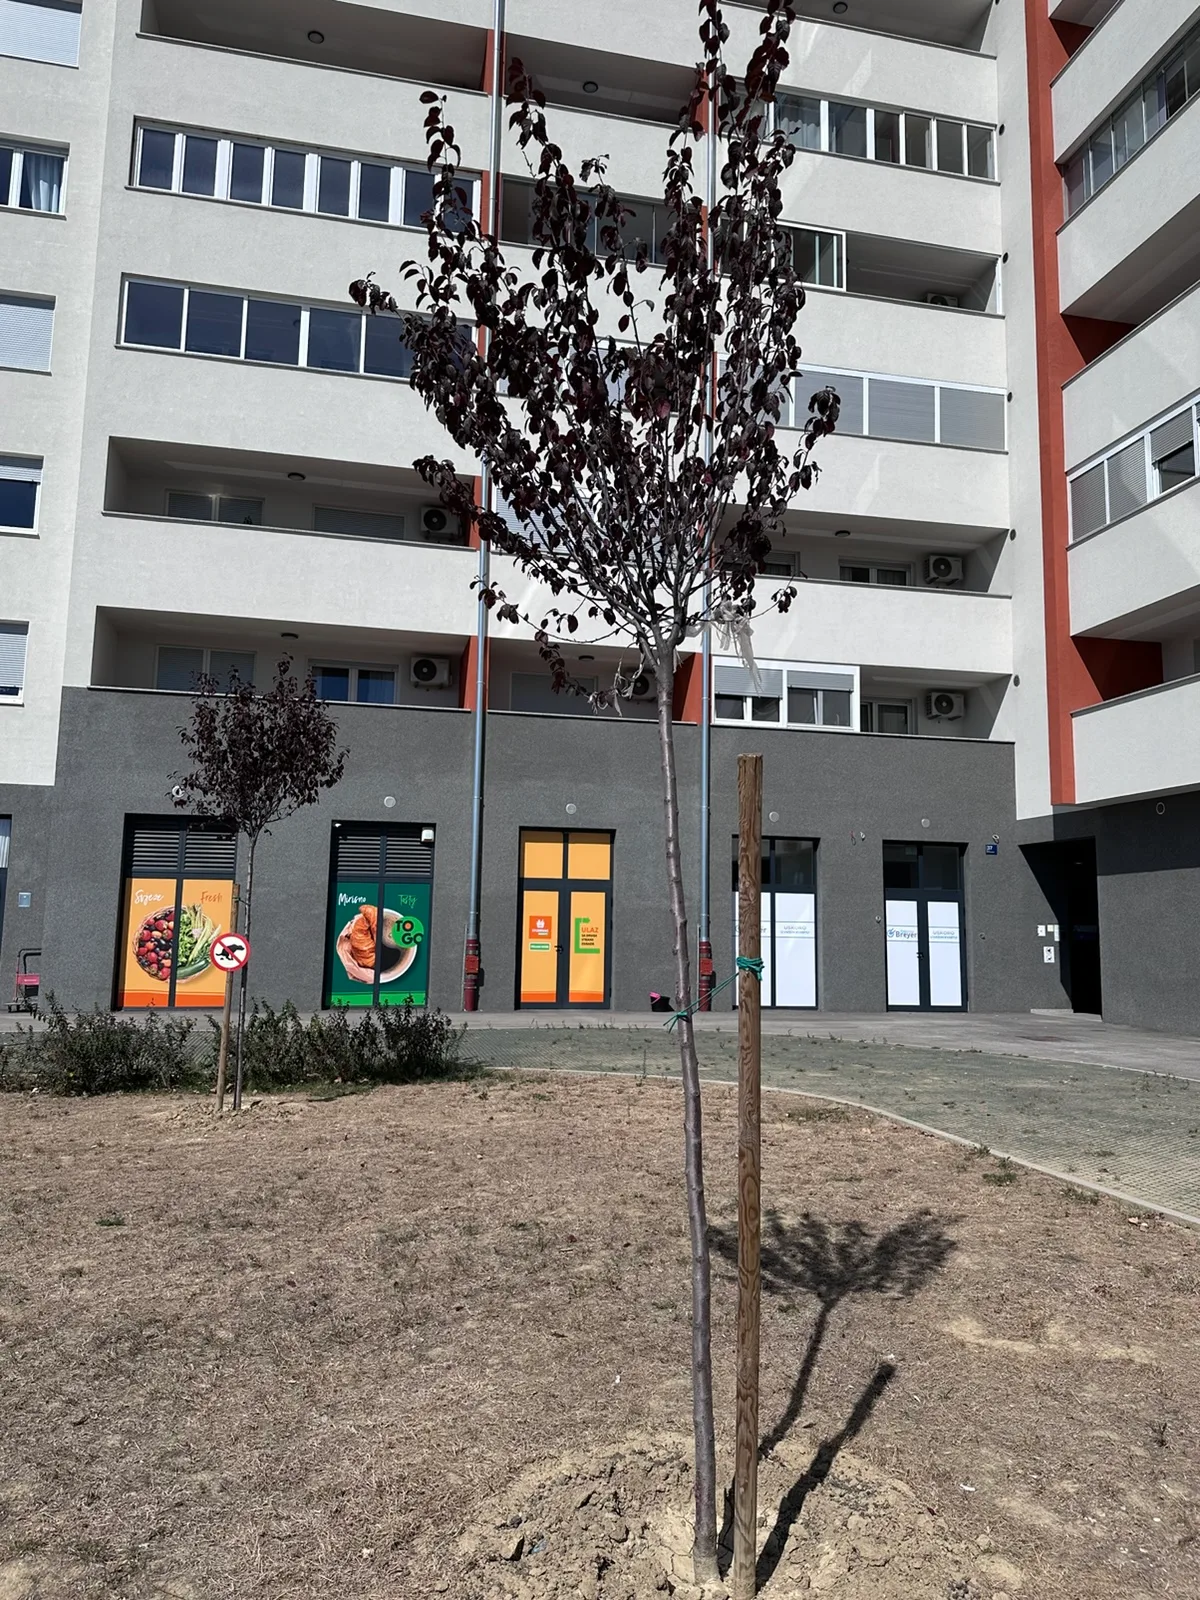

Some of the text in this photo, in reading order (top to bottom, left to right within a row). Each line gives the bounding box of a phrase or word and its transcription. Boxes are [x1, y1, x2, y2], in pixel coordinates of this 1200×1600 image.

[200, 891, 223, 904] Fresh
[338, 893, 367, 906] Mirisno
[395, 920, 414, 932] TO
[401, 933, 424, 945] GO
[895, 930, 917, 939] Breyer
